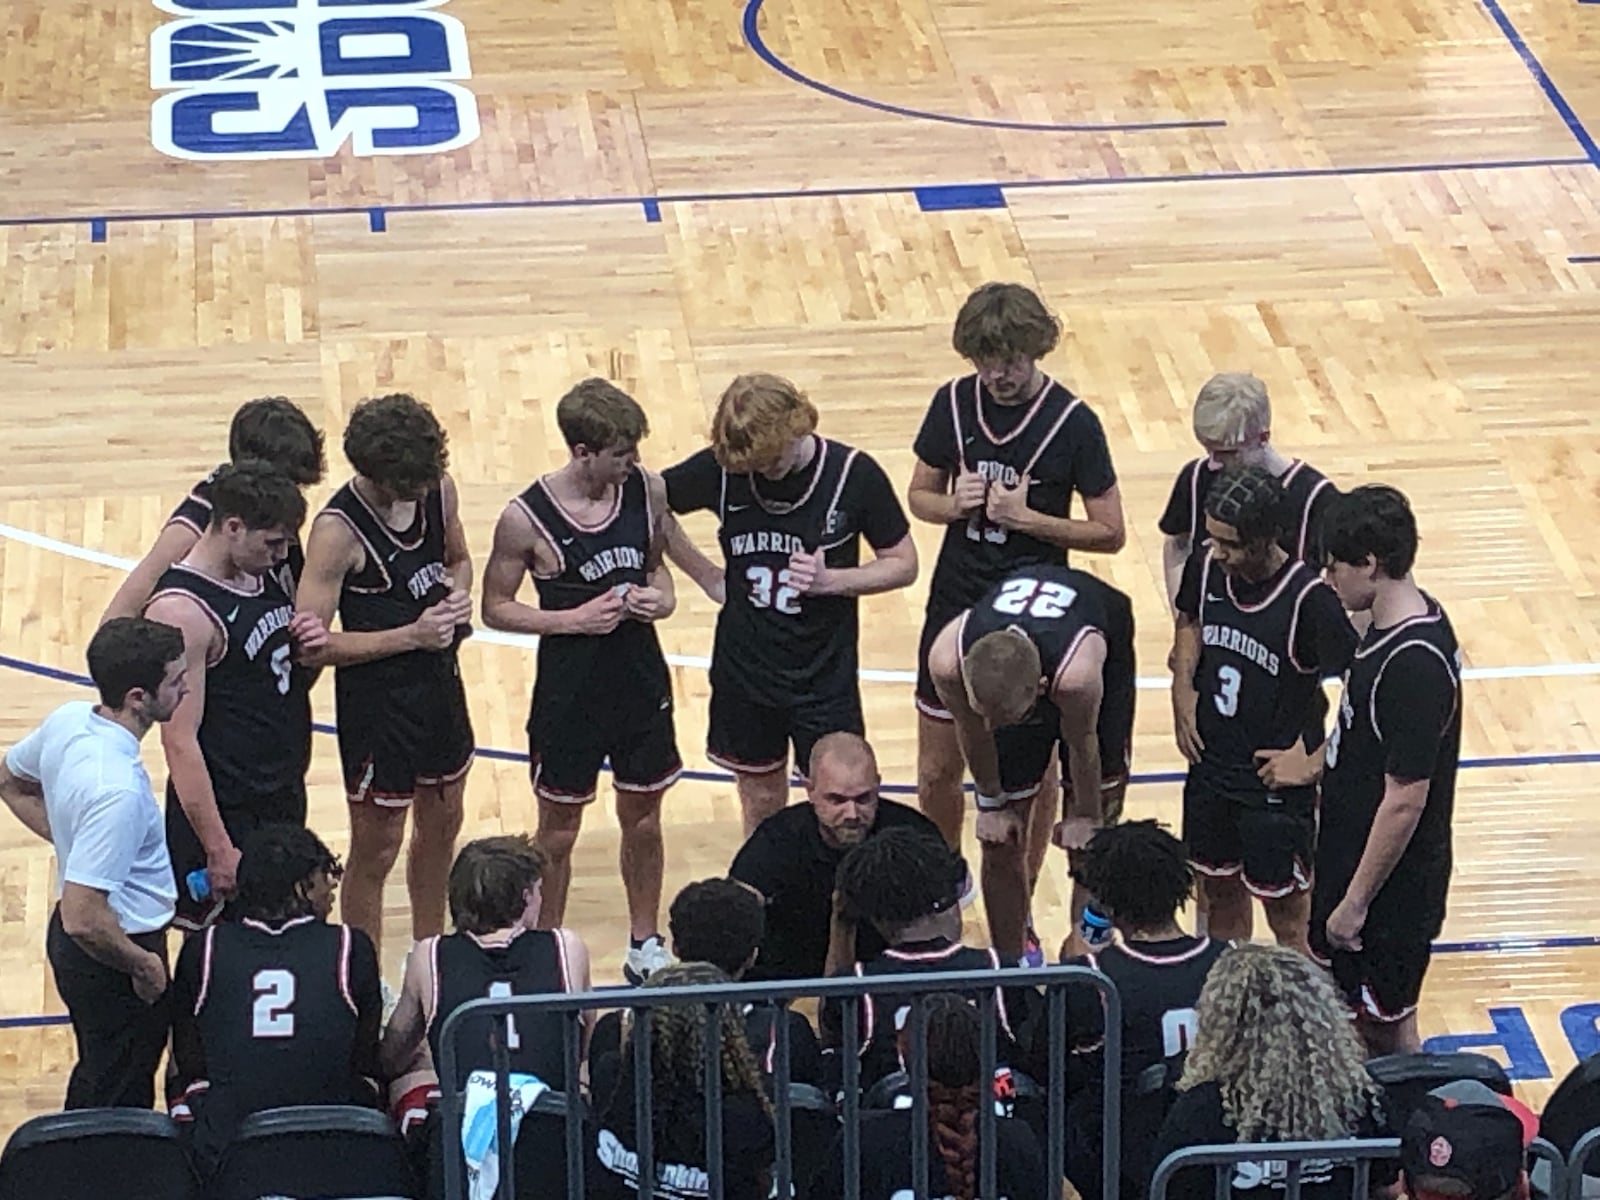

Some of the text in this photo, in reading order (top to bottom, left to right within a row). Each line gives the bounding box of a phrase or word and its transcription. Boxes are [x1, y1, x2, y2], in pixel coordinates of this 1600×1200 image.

[746, 567, 802, 614] 32
[992, 577, 1078, 619] 22
[270, 642, 293, 696] 5
[1202, 624, 1280, 677] WARRIORS
[1213, 664, 1242, 718] 3
[251, 968, 296, 1039] 2
